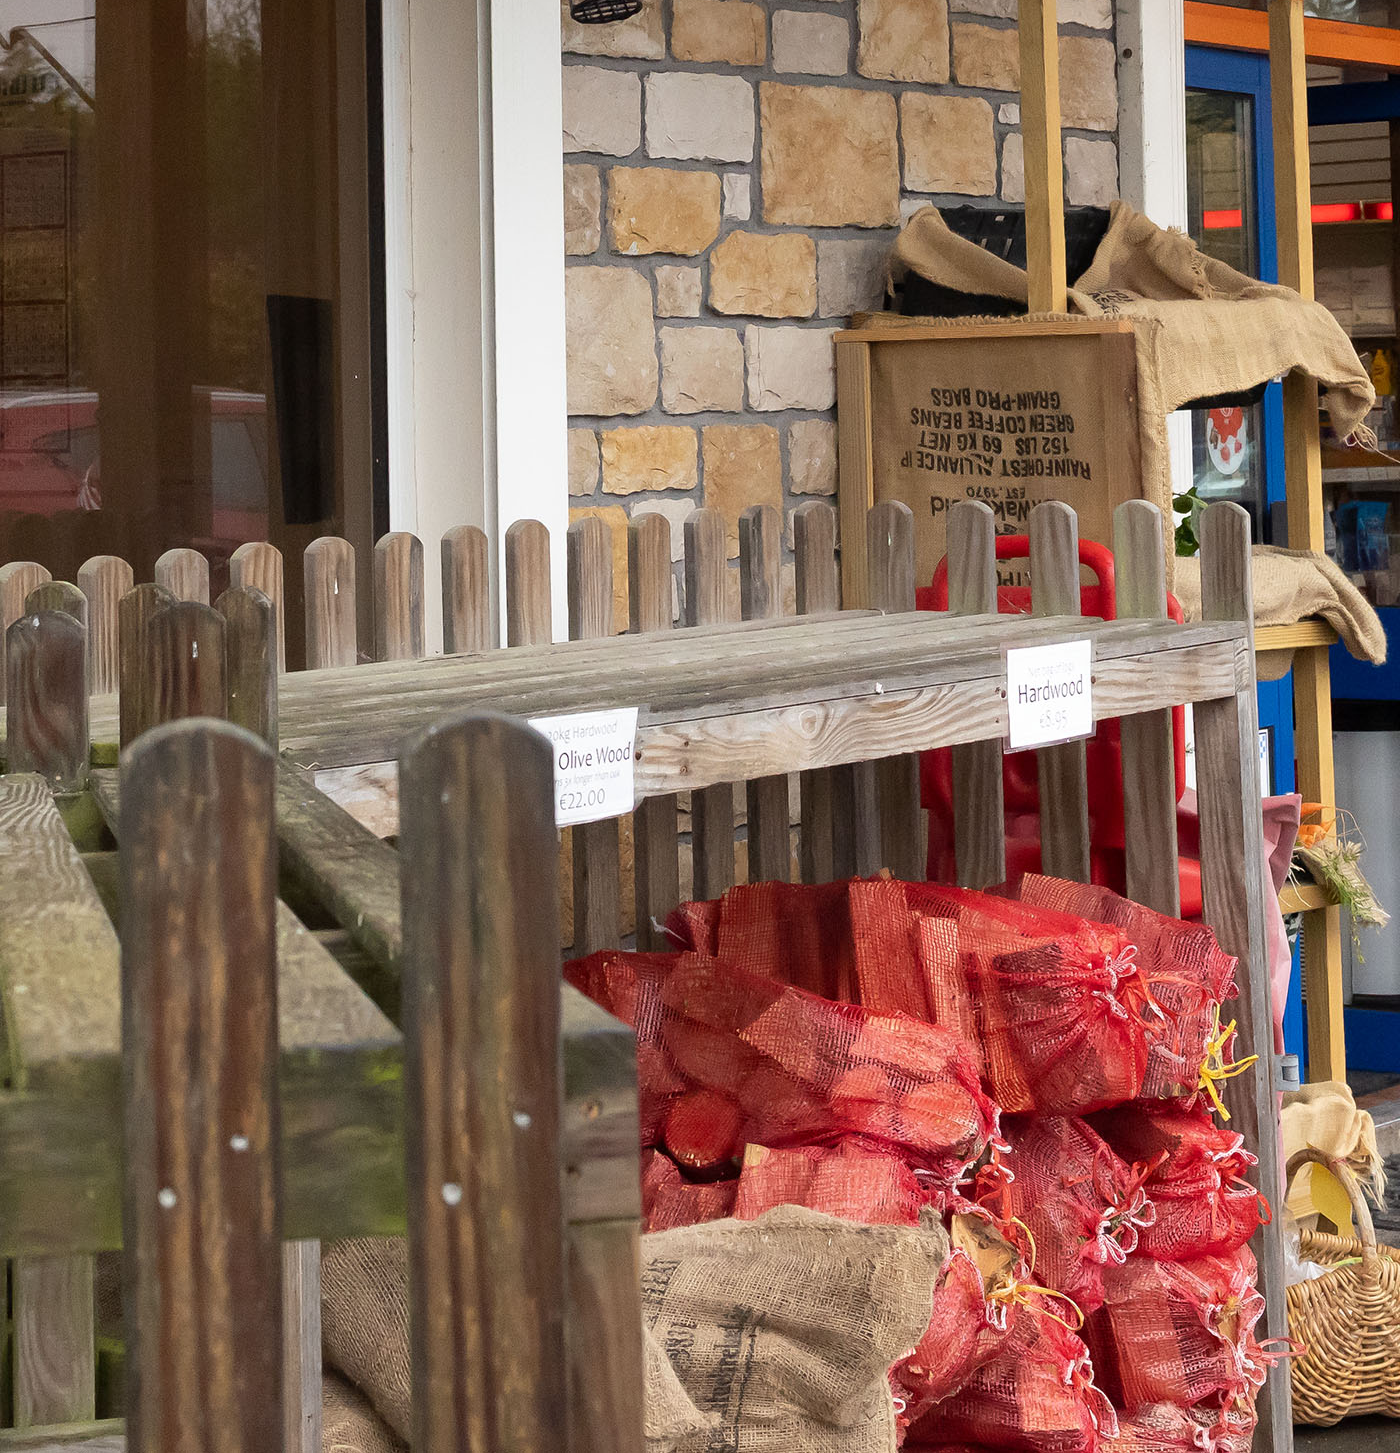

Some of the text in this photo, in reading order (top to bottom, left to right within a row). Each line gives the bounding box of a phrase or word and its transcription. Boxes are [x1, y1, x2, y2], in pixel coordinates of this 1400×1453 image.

[931, 388, 1060, 411] GRAIN-PRO BAGS
[910, 408, 1075, 434] GREEN COFFEE BEANS
[918, 430, 1070, 456] 152 LBS 69 KG NET
[917, 450, 994, 476] ALLIANCE
[1001, 458, 1092, 481] RAINFOREST
[1018, 674, 1083, 704] Hardwood
[573, 720, 618, 739] Hardwood
[559, 741, 631, 770] Olive Wood
[560, 788, 605, 810] €22.00
